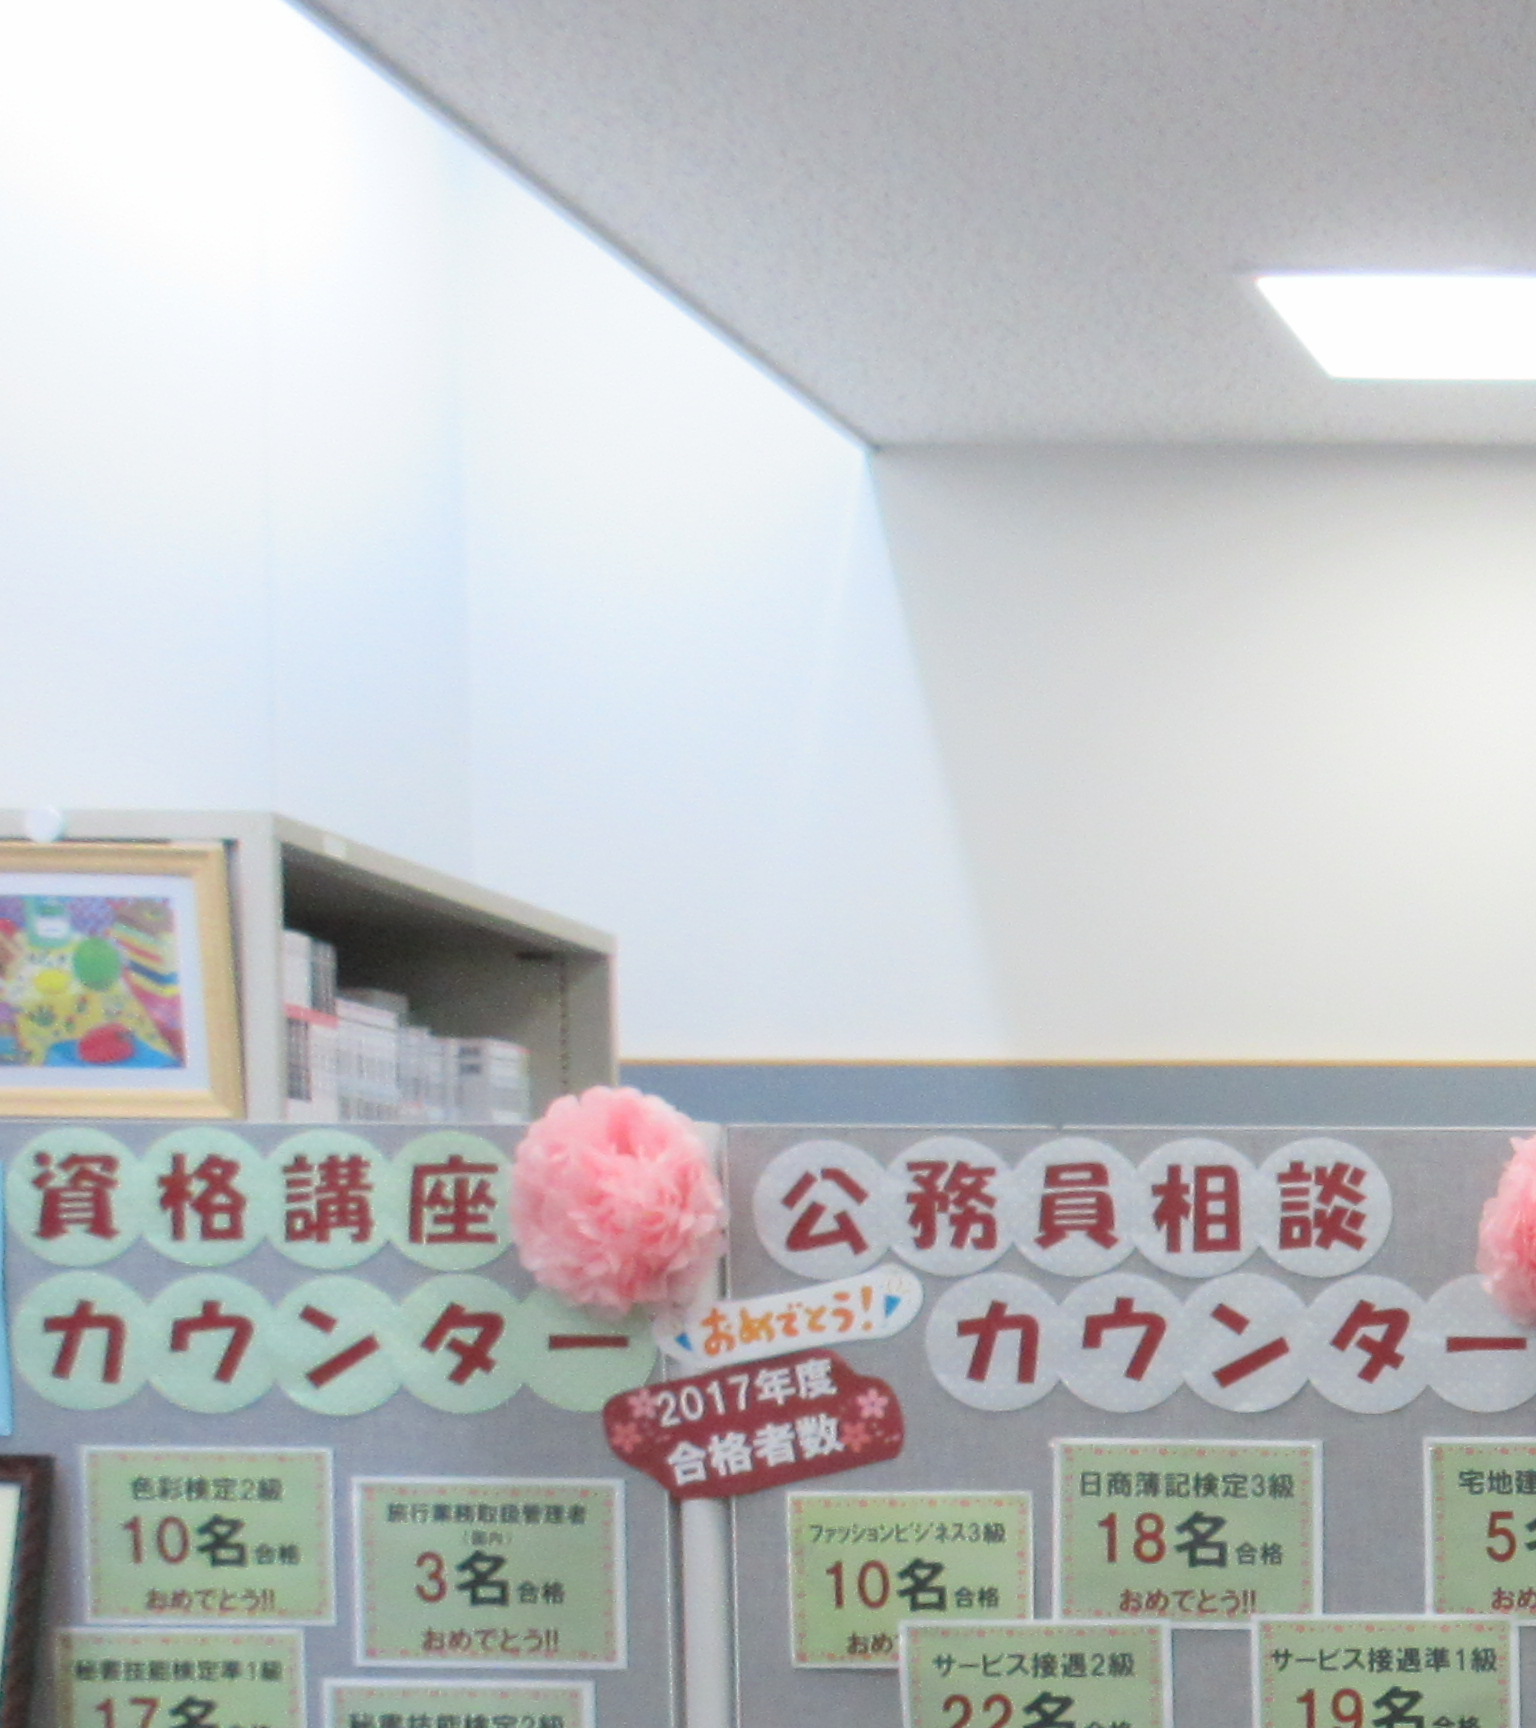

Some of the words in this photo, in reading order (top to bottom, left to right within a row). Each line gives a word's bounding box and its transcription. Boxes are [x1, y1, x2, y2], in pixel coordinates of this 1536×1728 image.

[33, 1150, 500, 1243] 資格講座
[783, 1160, 1366, 1256] 公務員相談
[43, 1299, 628, 1388] カウンター
[957, 1297, 1526, 1388] カウンター
[654, 1356, 838, 1428] 2017年度
[667, 1410, 845, 1484] 合格者数
[130, 1476, 284, 1501] 色彩検定2級
[1080, 1472, 1295, 1499] 日商簿記検定3級
[932, 1652, 1136, 1679] サービス接遇2級
[1271, 1647, 1498, 1672] サービス接遇準1級
